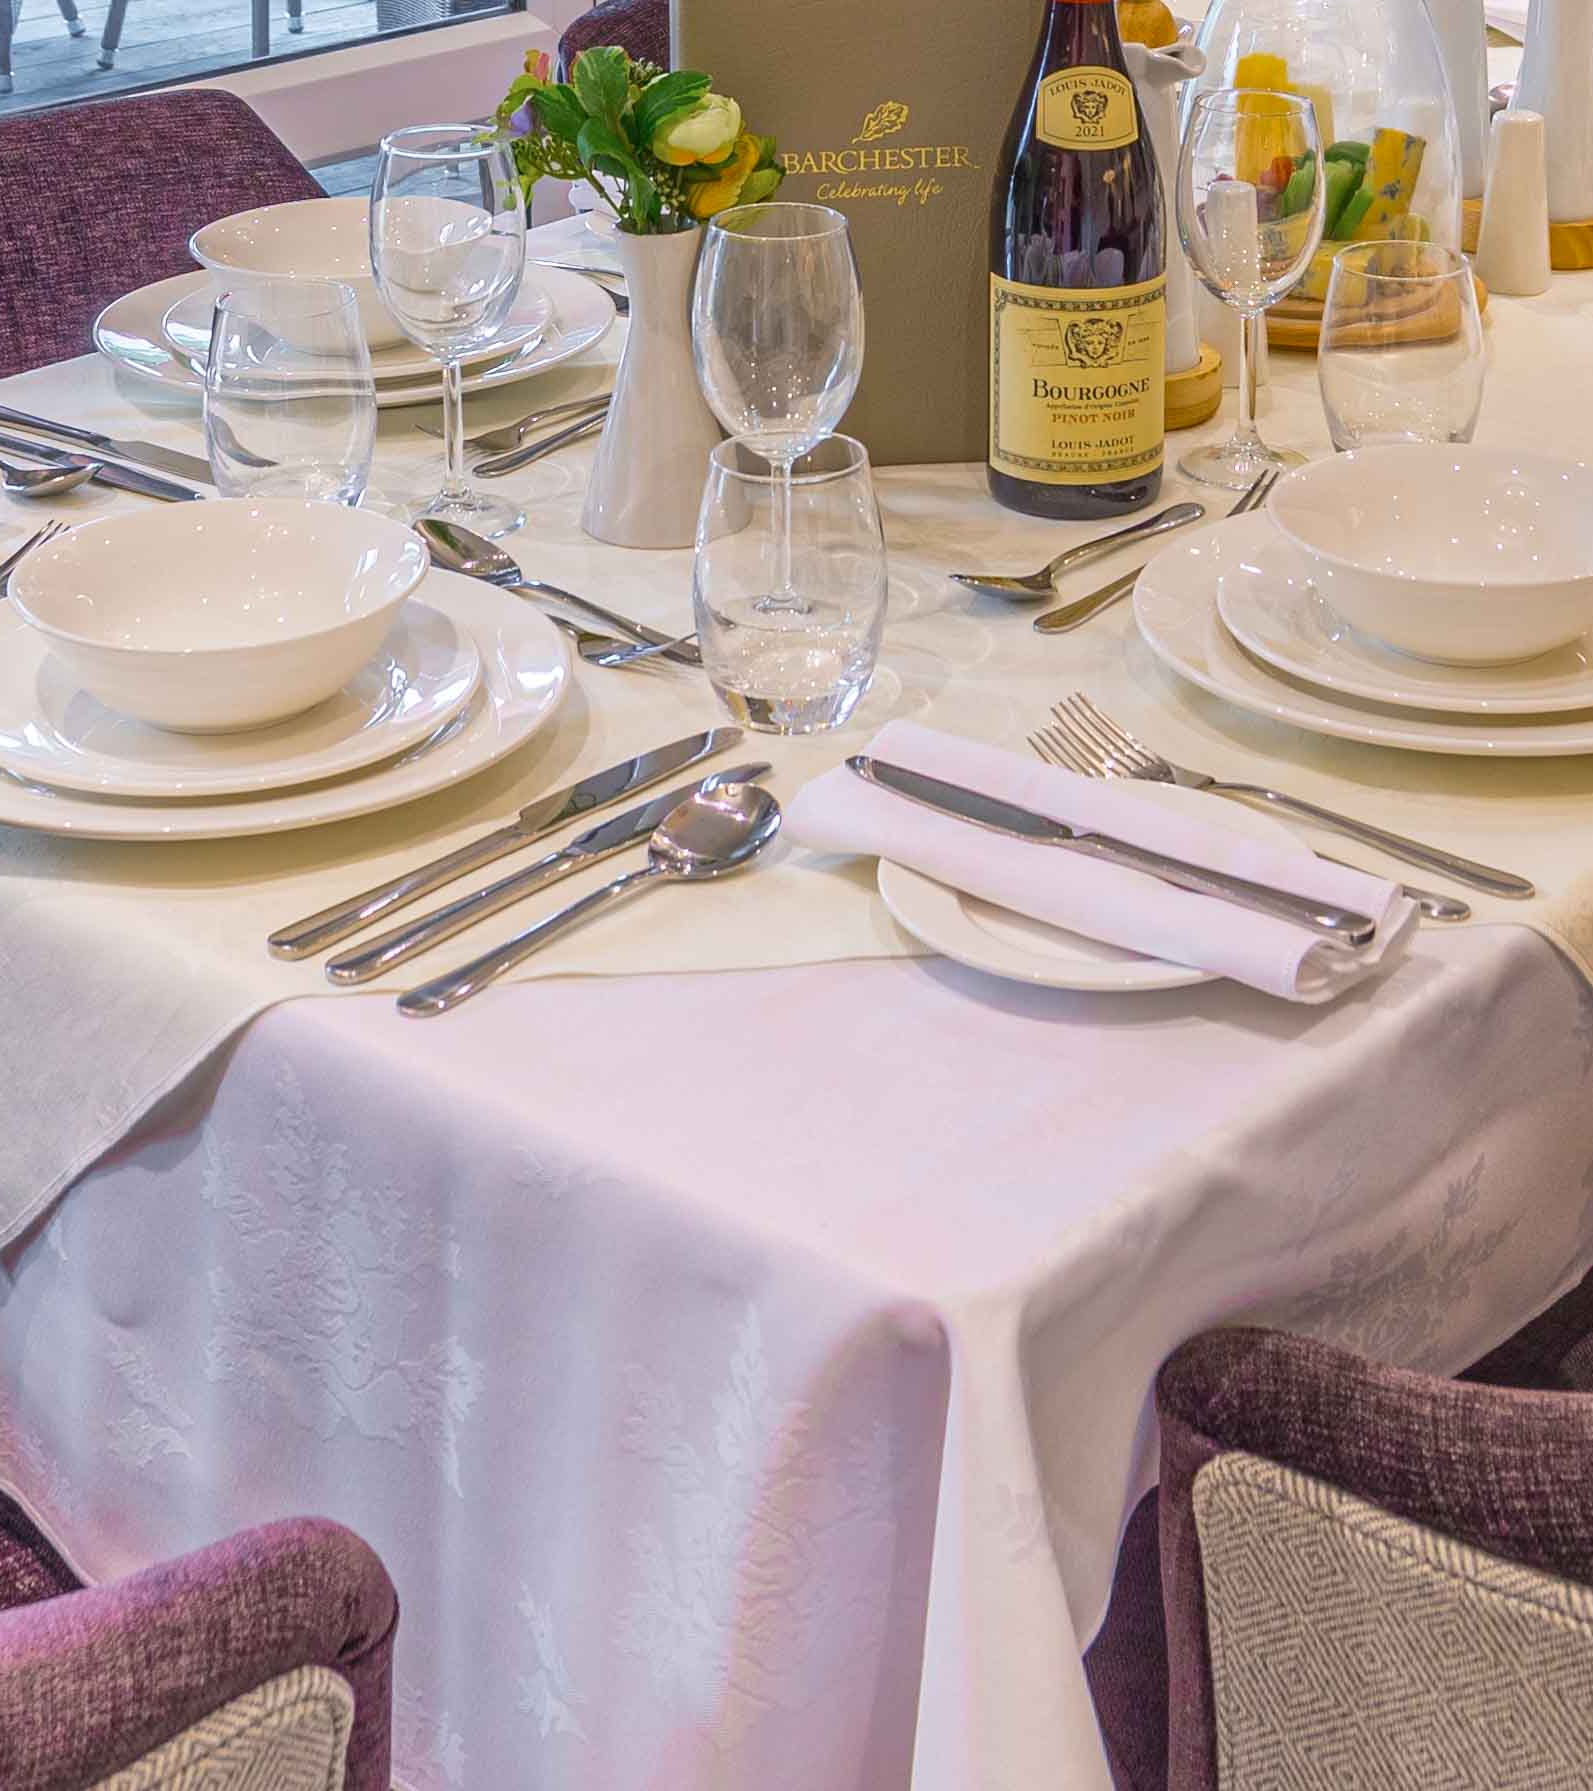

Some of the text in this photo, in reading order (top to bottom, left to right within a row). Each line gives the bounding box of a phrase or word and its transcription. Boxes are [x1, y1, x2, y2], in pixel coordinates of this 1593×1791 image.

[1049, 79, 1128, 97] LOUIS JADOT
[1075, 126, 1104, 137] 2021
[782, 145, 981, 175] BARCHESTER
[816, 177, 944, 206] Celebrating life
[1032, 377, 1151, 400] BOURGOGNE
[1052, 408, 1136, 424] PINOT NOIR
[1051, 435, 1134, 450] LOUIS JADOT
